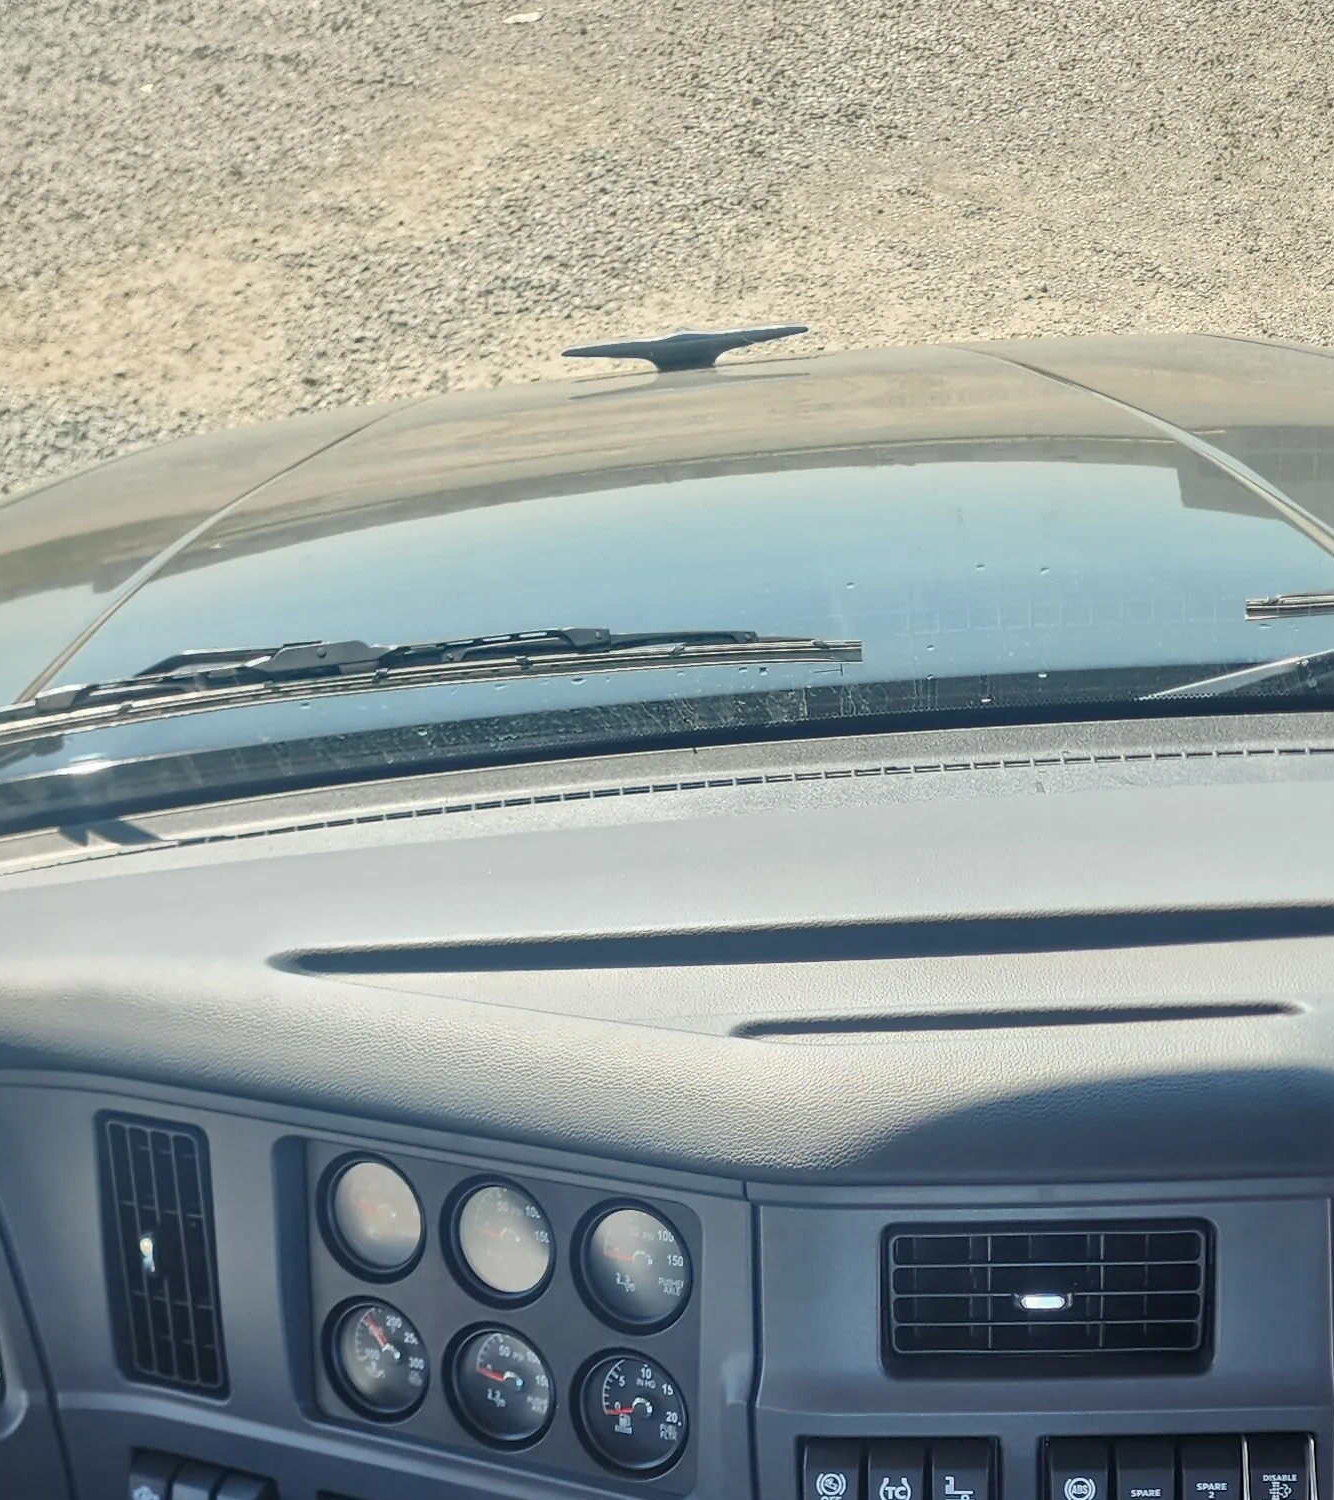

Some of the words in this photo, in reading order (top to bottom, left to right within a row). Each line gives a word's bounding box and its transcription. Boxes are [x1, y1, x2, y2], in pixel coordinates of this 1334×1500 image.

[525, 1205, 541, 1218] 10
[667, 1255, 684, 1267] 150
[404, 1332, 419, 1345] 25
[640, 1367, 652, 1380] 10
[618, 1376, 626, 1387] 5
[662, 1383, 674, 1396] 15
[666, 1411, 678, 1423] 20
[1262, 1474, 1297, 1482] DISABLE
[1071, 1485, 1089, 1495] ABS
[1196, 1482, 1228, 1491] SPARE
[884, 1486, 907, 1500] TC
[1130, 1489, 1161, 1498] SPARE
